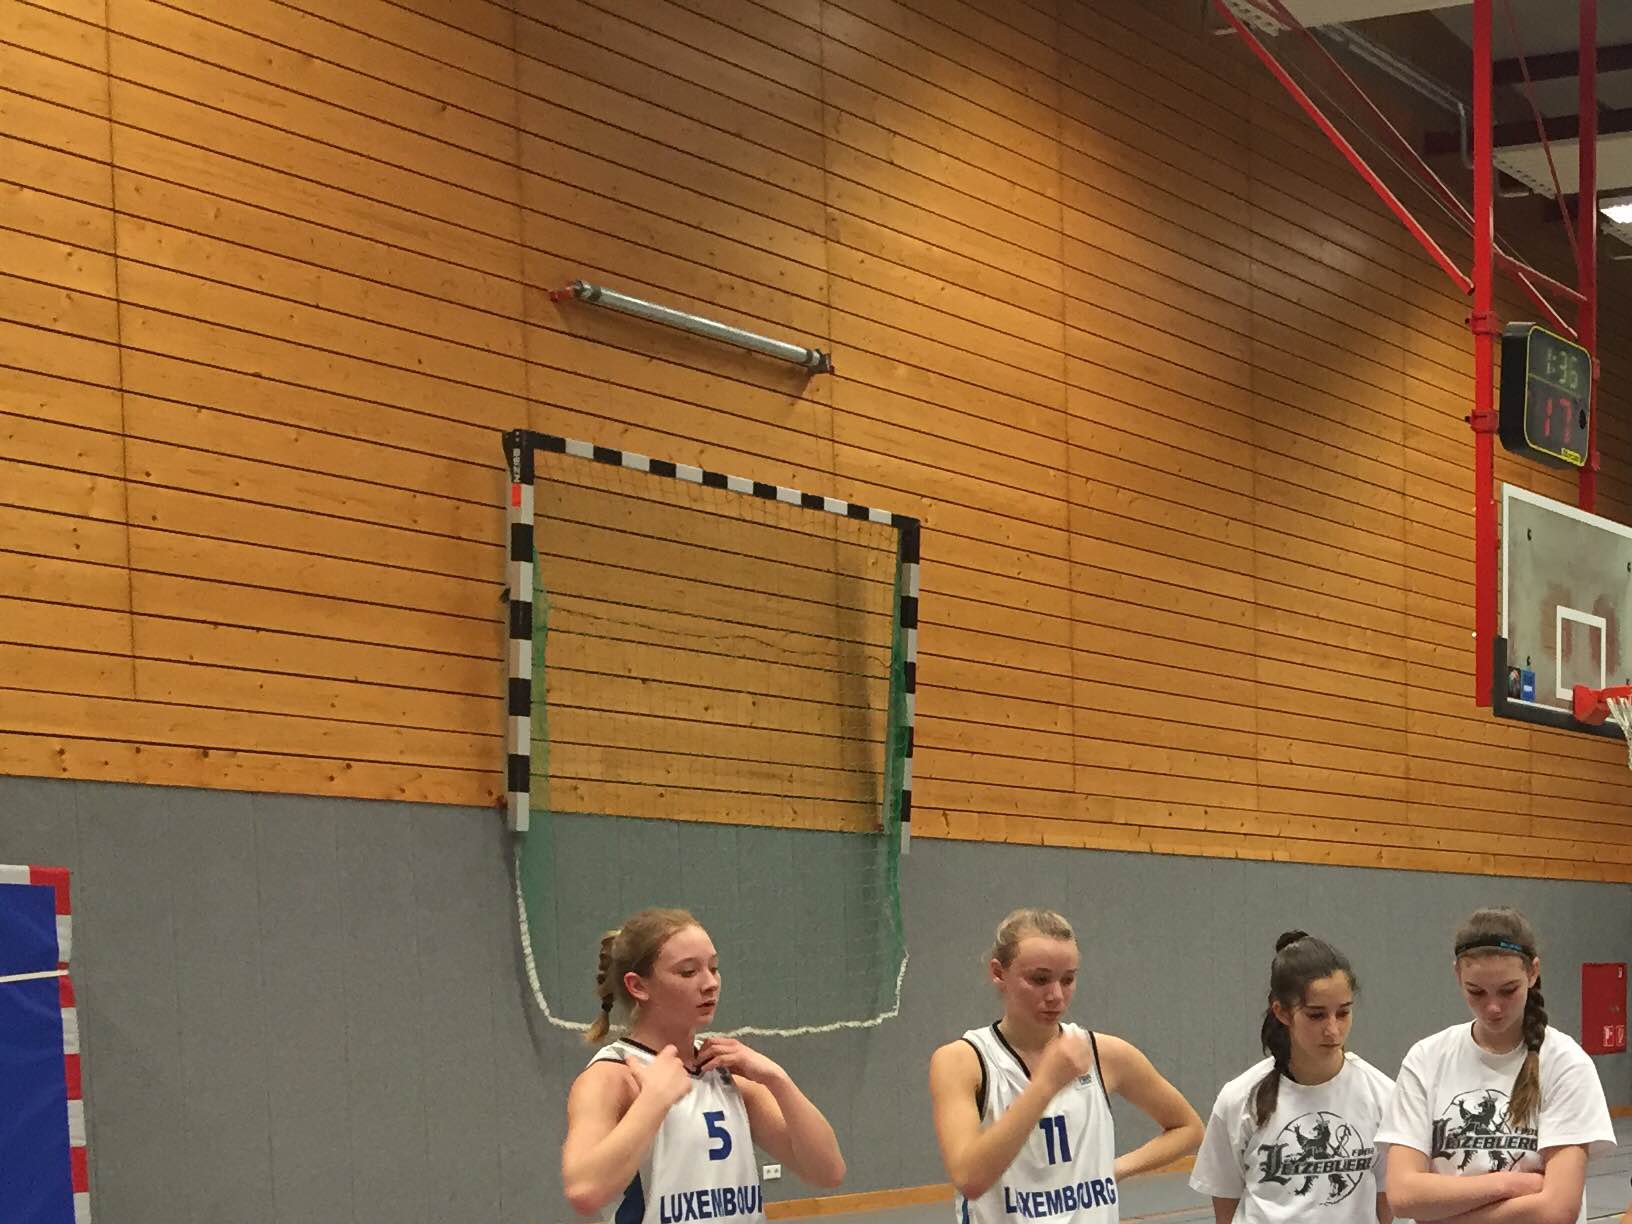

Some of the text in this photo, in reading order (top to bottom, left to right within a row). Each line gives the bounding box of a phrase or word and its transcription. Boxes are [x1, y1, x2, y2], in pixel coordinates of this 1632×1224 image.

[1543, 398, 1574, 443] 17
[703, 1111, 732, 1161] 5
[1039, 1115, 1073, 1165] 11
